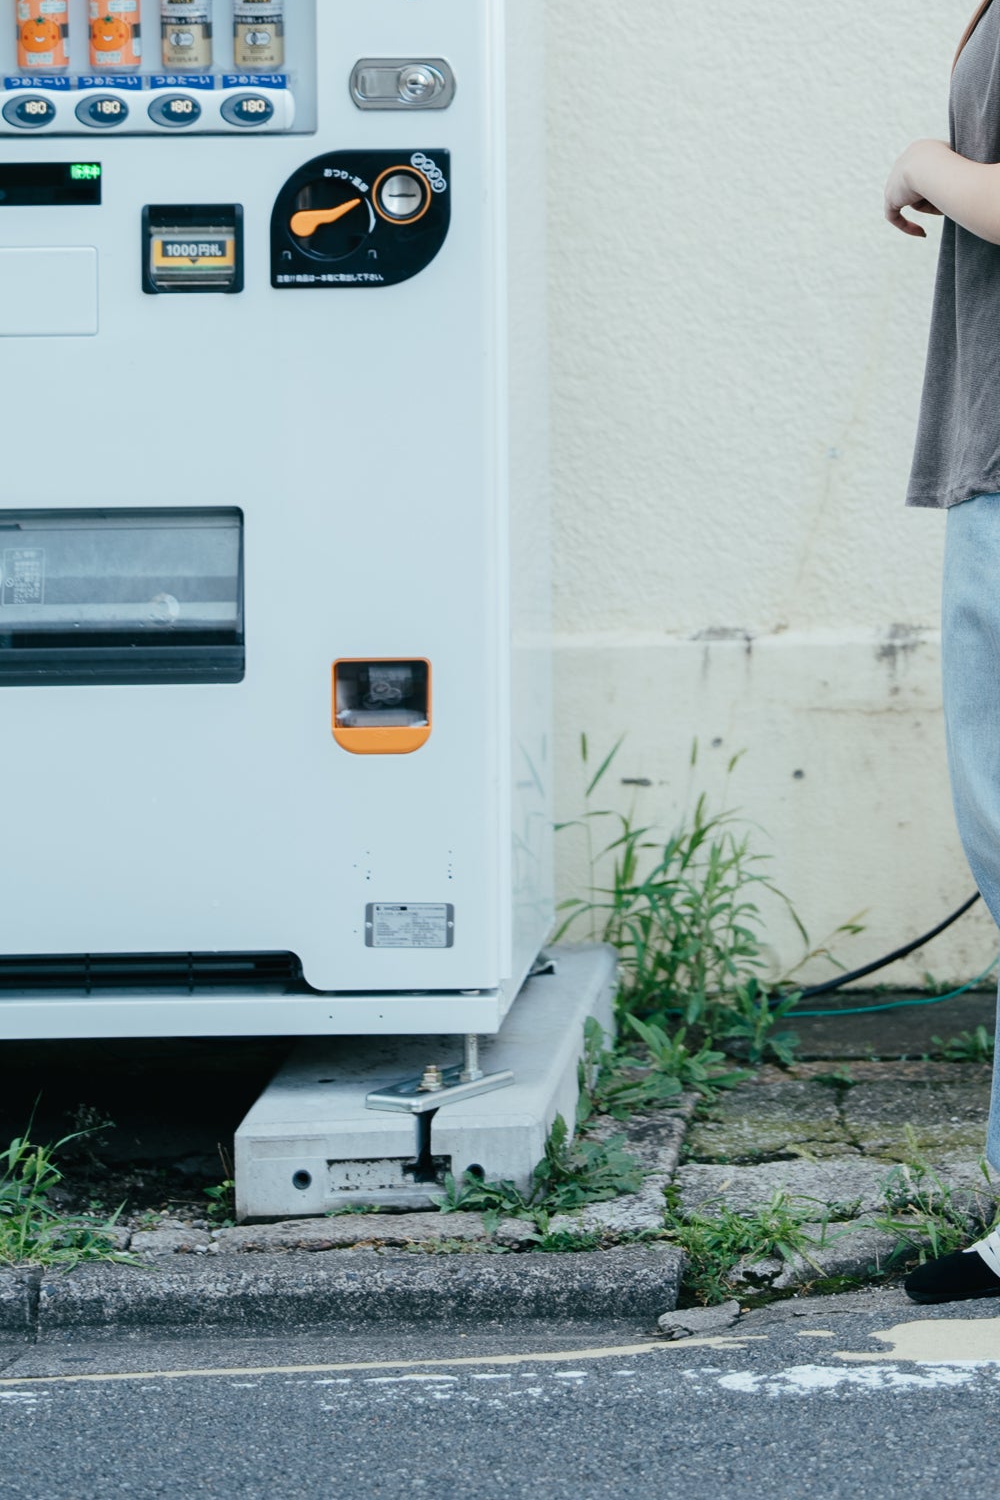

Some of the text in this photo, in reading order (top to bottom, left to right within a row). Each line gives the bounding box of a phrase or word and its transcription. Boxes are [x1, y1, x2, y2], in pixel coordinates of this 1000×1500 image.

[25, 101, 47, 115] 180
[97, 100, 120, 114] 180
[170, 100, 192, 113] 180
[242, 99, 265, 113] 180
[166, 244, 222, 256] 1000円札
